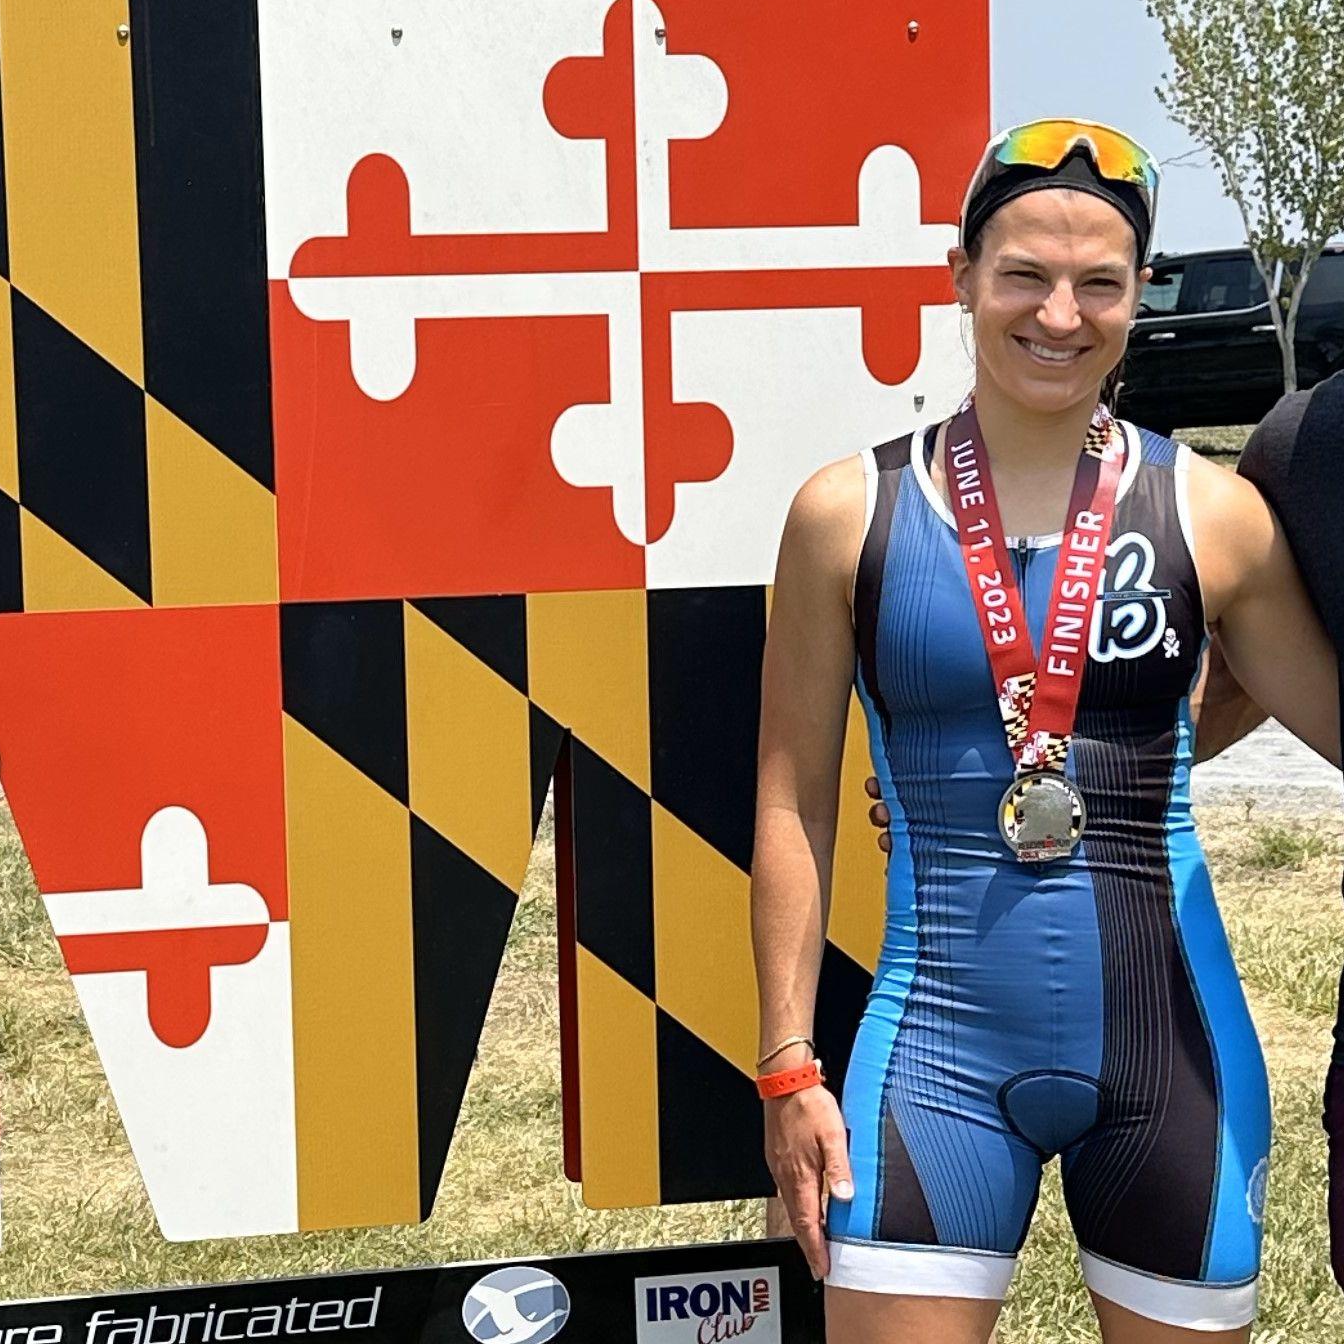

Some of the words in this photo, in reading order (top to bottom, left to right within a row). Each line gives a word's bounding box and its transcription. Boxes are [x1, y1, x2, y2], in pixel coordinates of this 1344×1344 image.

[951, 439, 985, 509] JUNE
[967, 518, 994, 563] 11,
[977, 570, 1017, 646] 2023
[1047, 510, 1105, 677] FINISHER
[646, 1280, 751, 1322] IRON
[753, 1278, 770, 1312] MD
